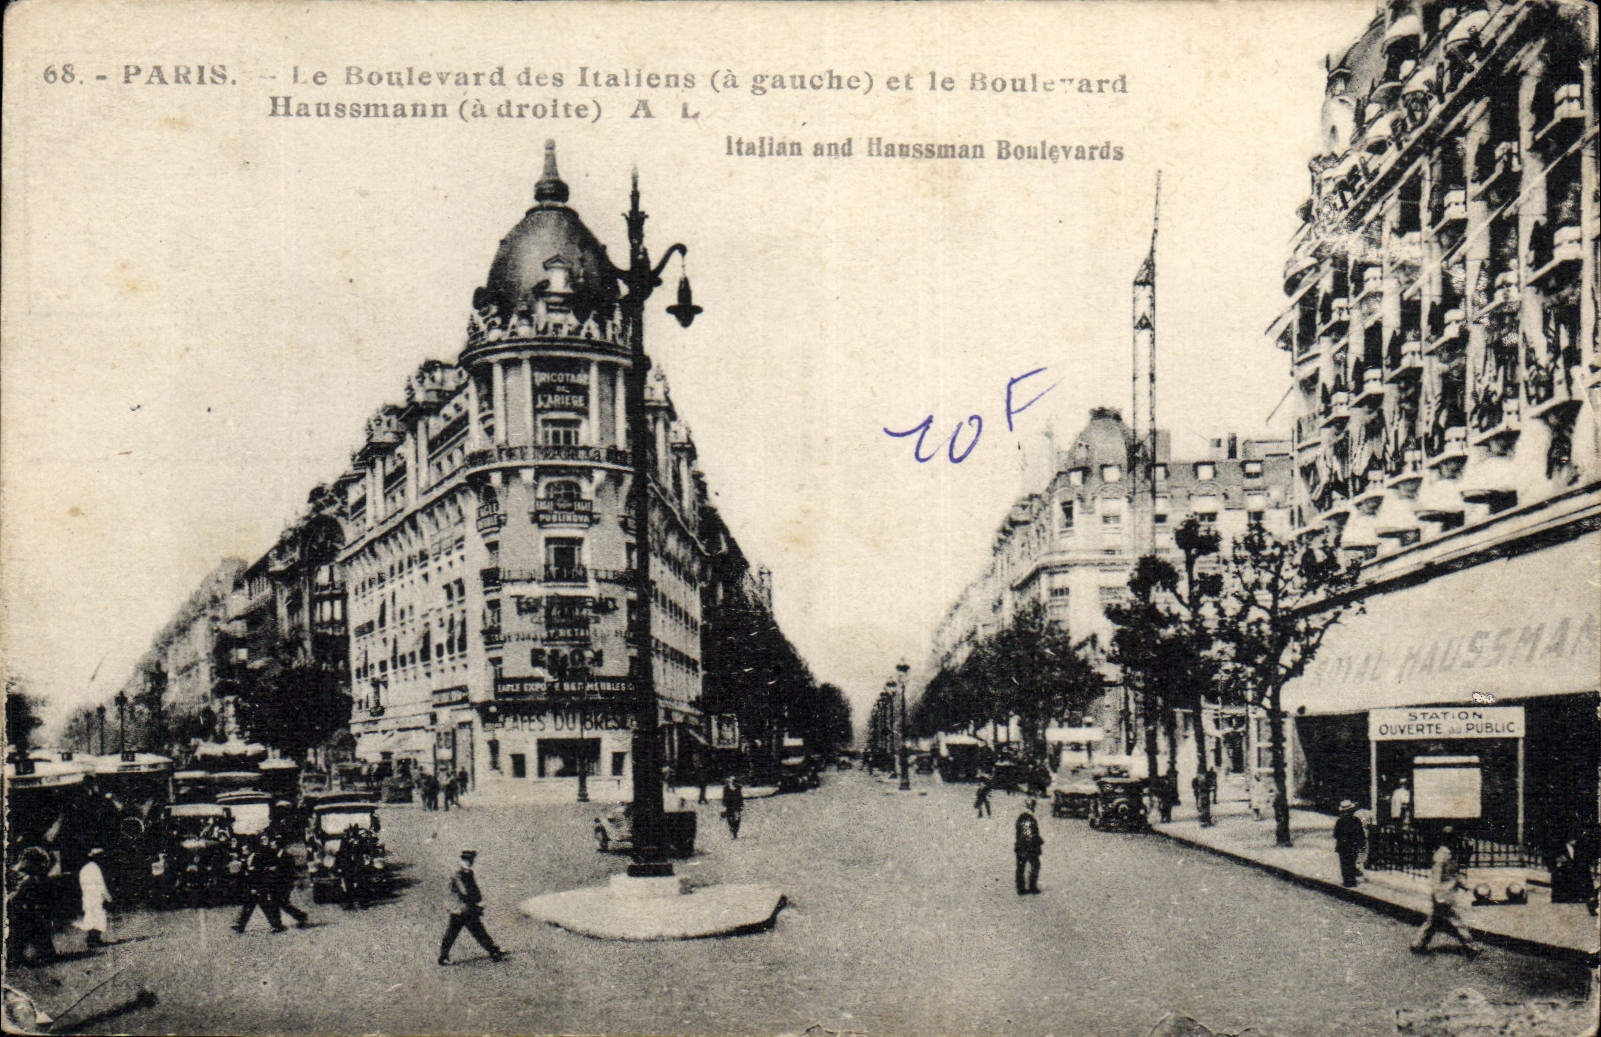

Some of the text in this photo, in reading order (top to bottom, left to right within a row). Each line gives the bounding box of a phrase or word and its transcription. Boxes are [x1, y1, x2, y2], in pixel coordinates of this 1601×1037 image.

[1408, 711, 1483, 722] STATION
[1378, 723, 1443, 735] OUVERTE
[1466, 721, 1516, 734] PUBLIC
